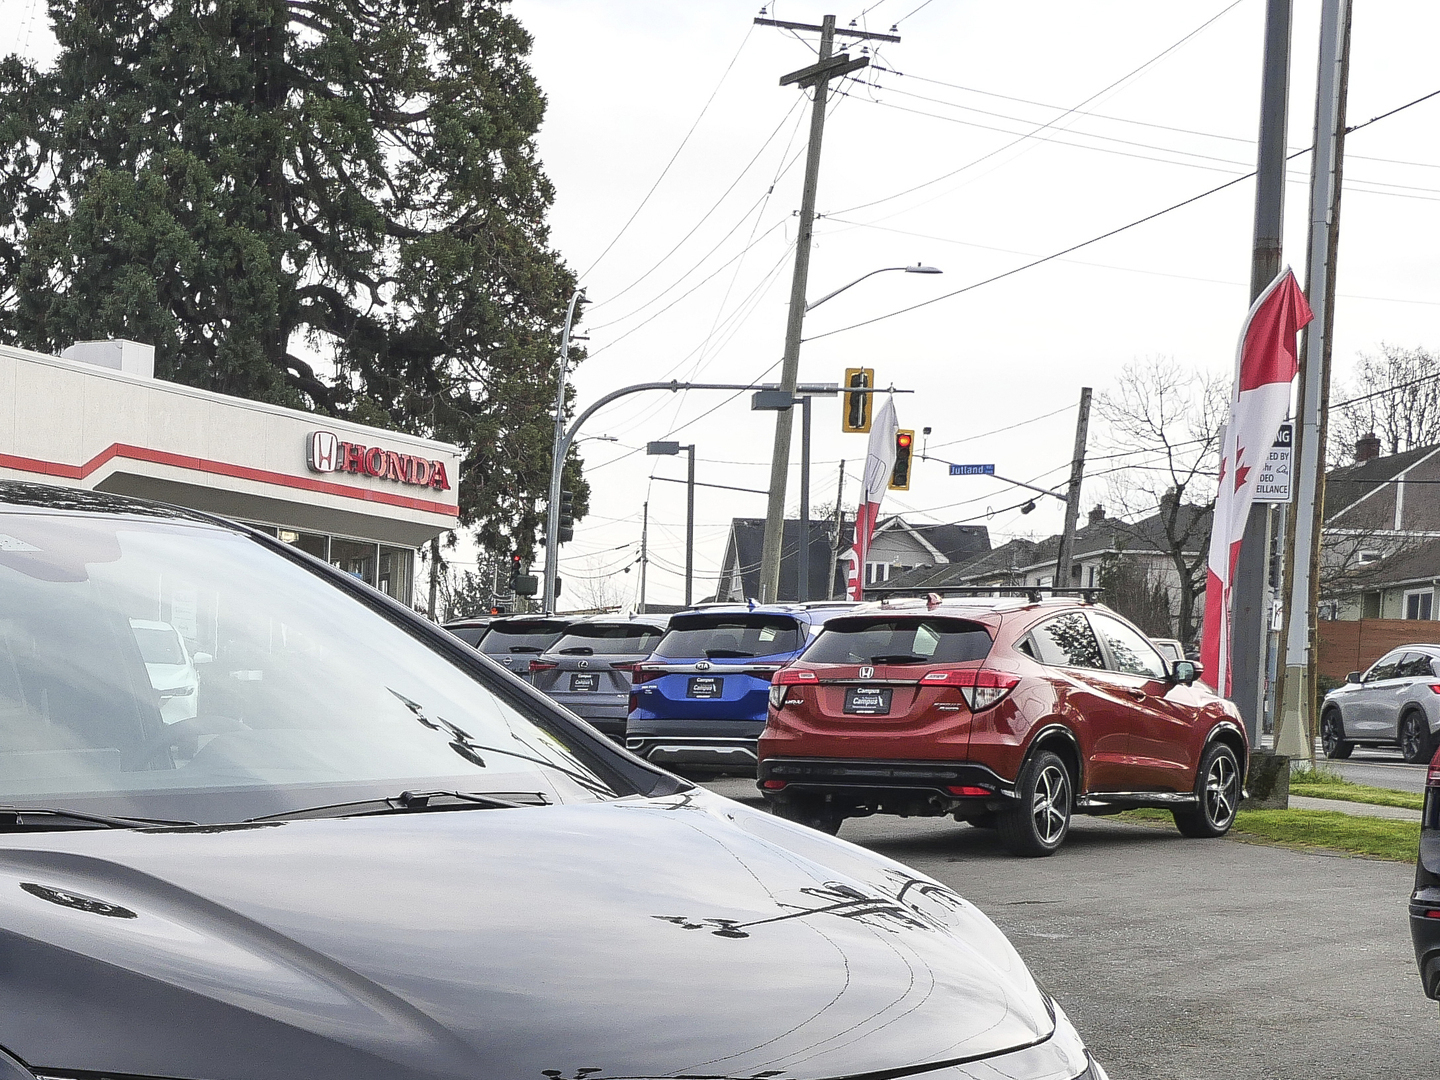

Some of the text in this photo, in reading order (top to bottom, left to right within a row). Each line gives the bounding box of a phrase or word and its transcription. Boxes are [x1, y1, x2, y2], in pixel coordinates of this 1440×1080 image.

[340, 441, 451, 490] HONDA
[1259, 474, 1274, 482] DEO
[1256, 484, 1288, 494] EILLANCE
[852, 697, 878, 707] Campus
